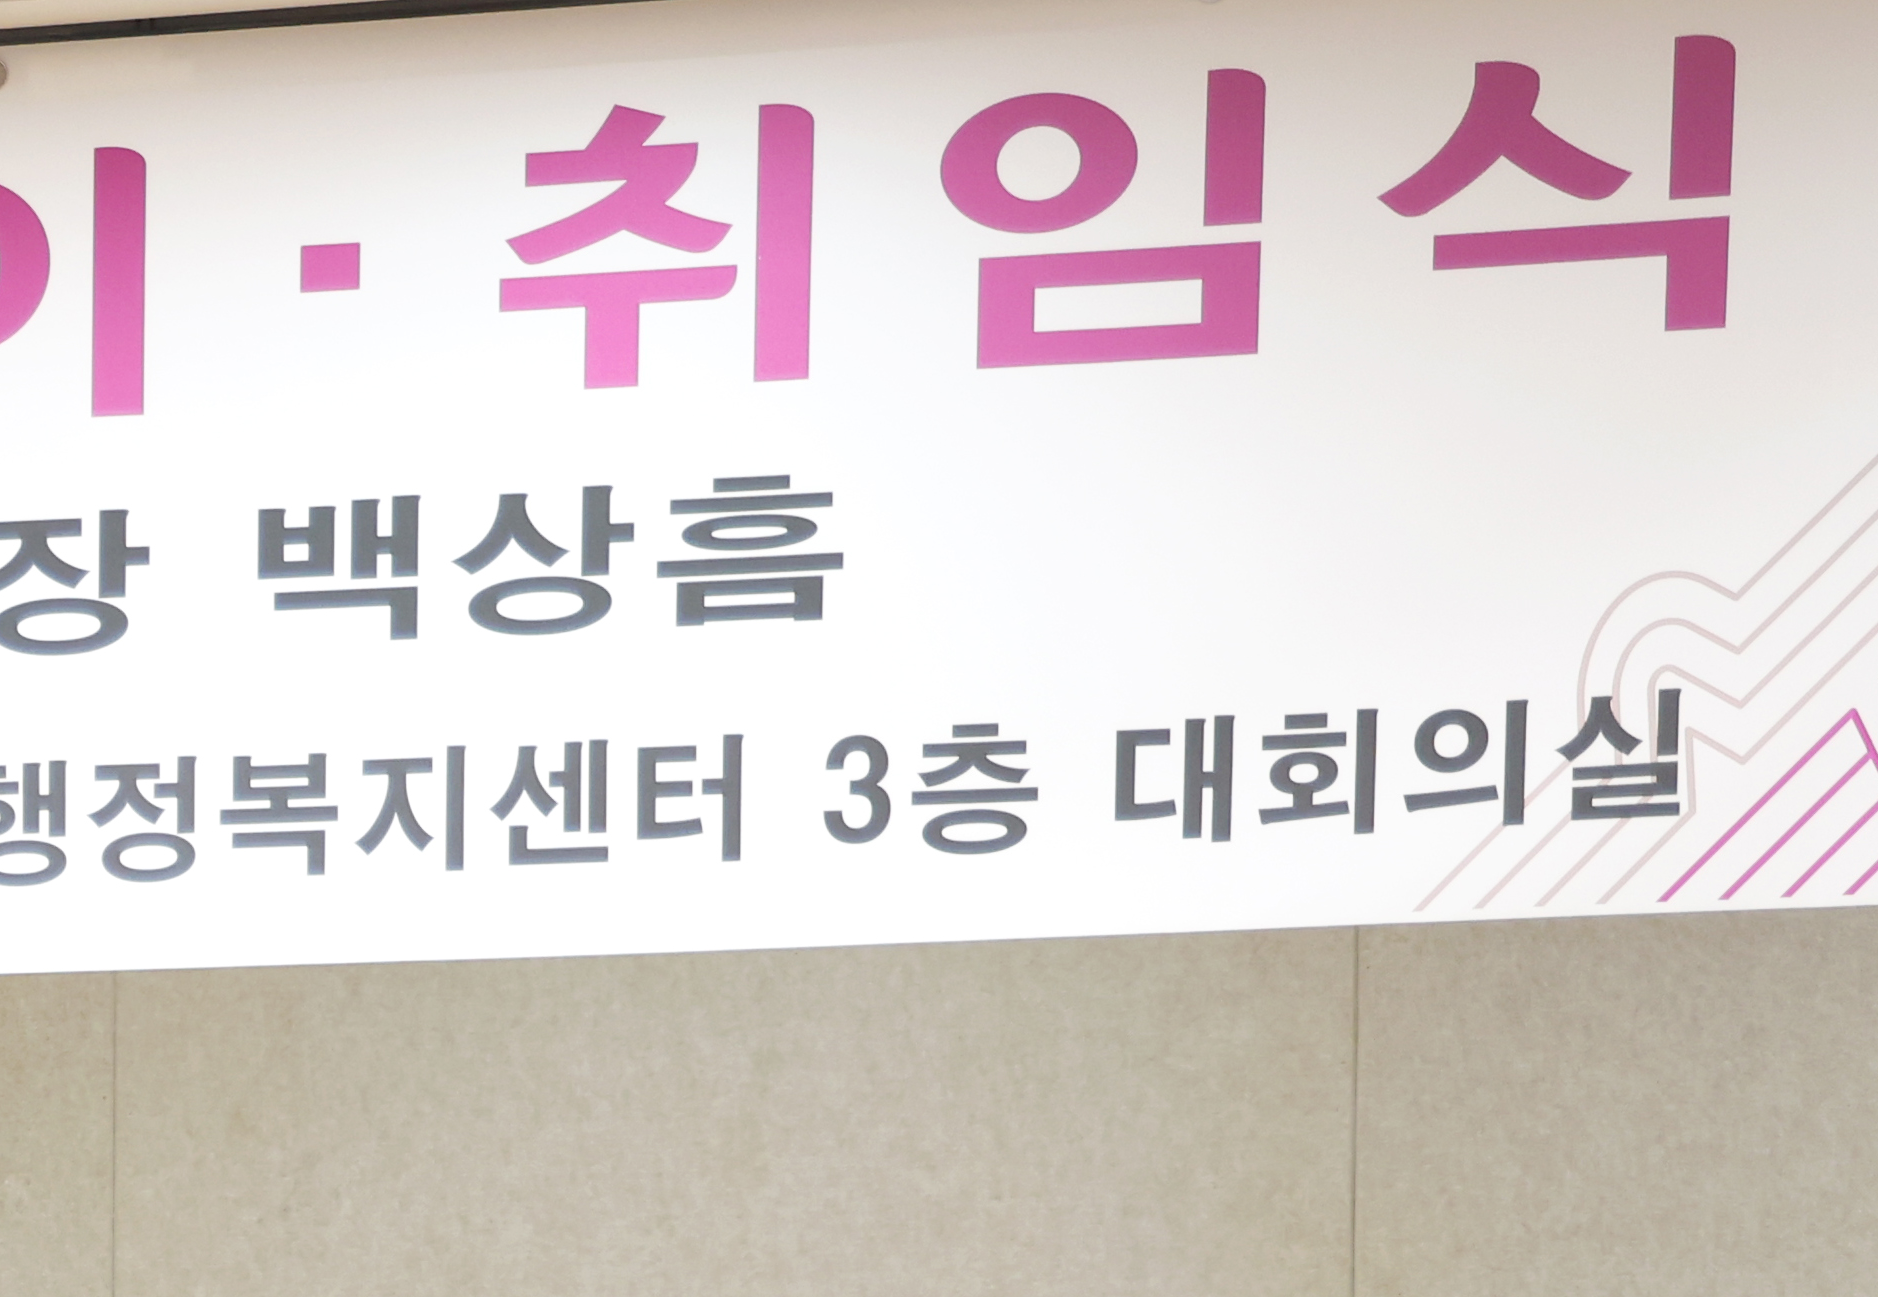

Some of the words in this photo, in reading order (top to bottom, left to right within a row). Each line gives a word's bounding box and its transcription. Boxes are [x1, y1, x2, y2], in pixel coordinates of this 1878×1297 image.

[256, 473, 845, 641] 백상흠
[822, 721, 1041, 855] 3층
[1113, 686, 1684, 842] 대회의실
